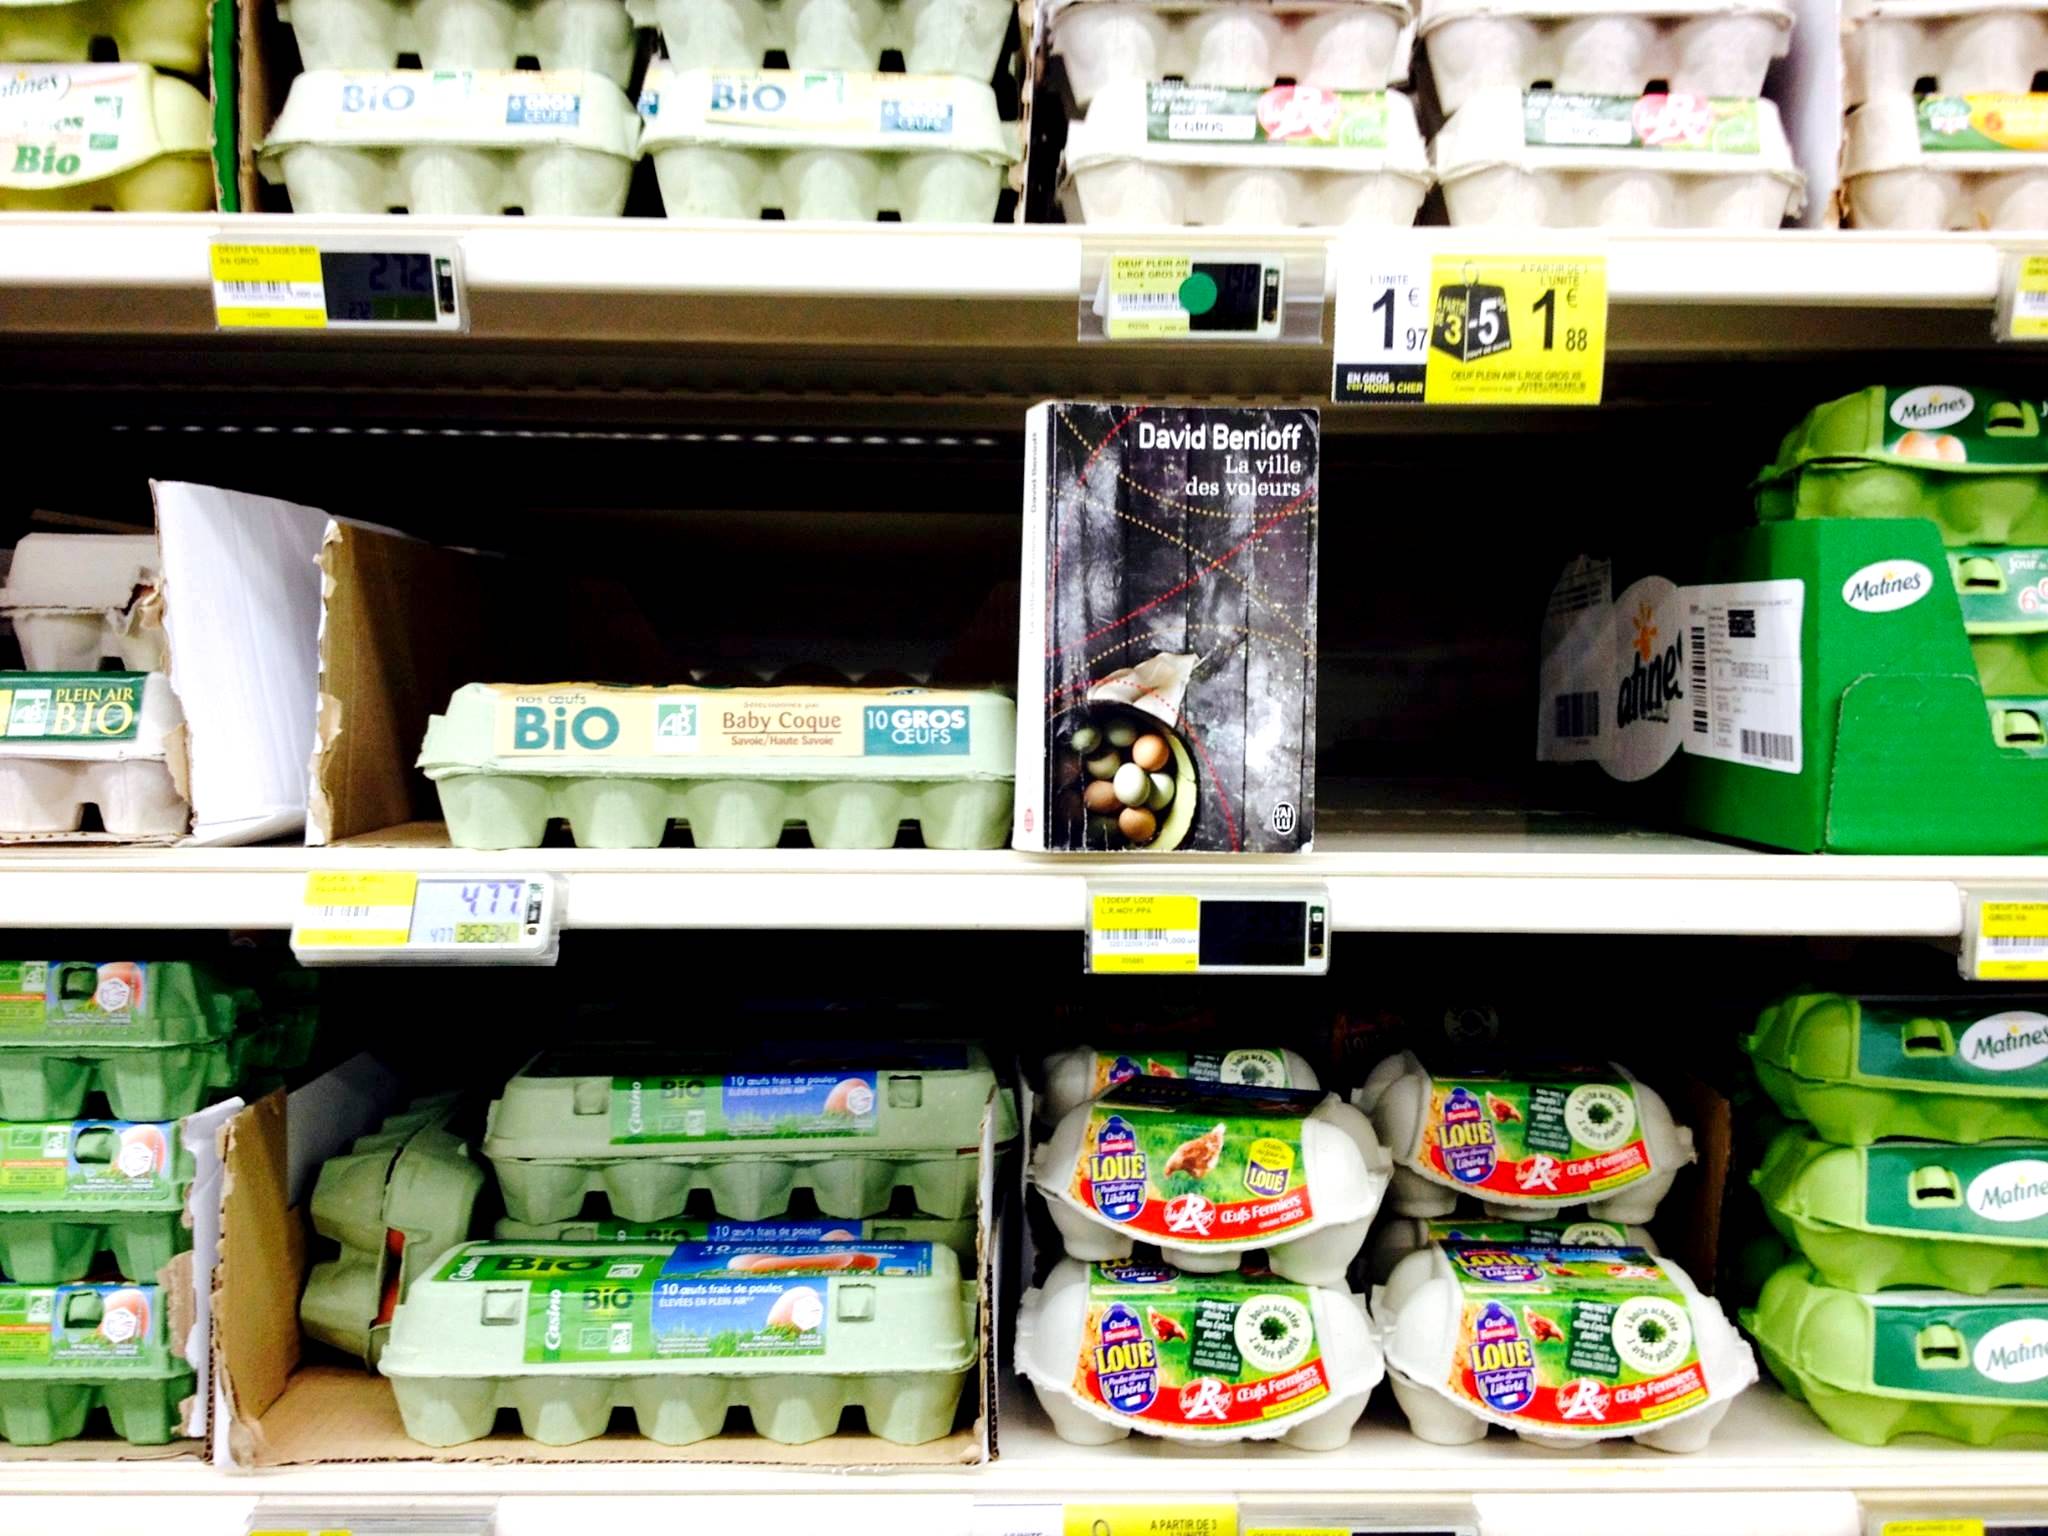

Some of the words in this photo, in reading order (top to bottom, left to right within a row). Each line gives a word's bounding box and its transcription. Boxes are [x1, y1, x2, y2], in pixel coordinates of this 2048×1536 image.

[342, 85, 415, 112] BiO
[711, 83, 786, 112] BiO
[13, 144, 80, 175] Bio
[1146, 260, 1173, 268] PLEIN
[1372, 288, 1396, 351] 1
[1405, 328, 1428, 351] 97
[1444, 315, 1462, 345] 3
[1532, 289, 1556, 350] 1
[1565, 328, 1588, 351] 88
[1362, 371, 1390, 383] GROS
[1363, 382, 1396, 395] MOINS
[1397, 382, 1424, 394] CHER
[1900, 397, 1967, 423] Matines
[1138, 422, 1206, 450] David
[1212, 423, 1303, 450] Benioff
[1225, 455, 1249, 474] La
[1255, 455, 1301, 474] ville
[1185, 476, 1219, 496] des
[1226, 476, 1301, 497] voleurs
[1849, 573, 1921, 602] Matines
[55, 687, 101, 702] PLEIN
[105, 687, 134, 701] AIR
[53, 701, 133, 735] BIO
[514, 706, 620, 750] BiO
[723, 711, 771, 734] Baby
[779, 711, 842, 733] Coque
[867, 710, 888, 730] 10
[891, 709, 966, 730] GROS
[801, 735, 834, 746] Savoie
[891, 729, 952, 744] ŒUFS
[661, 1080, 706, 1100] BiO
[730, 1076, 745, 1086] 10
[746, 1077, 770, 1086] œufs
[771, 1076, 796, 1086] frais
[797, 1076, 808, 1085] de
[808, 1076, 838, 1086] poules
[628, 1080, 643, 1135] Casino
[1251, 1195, 1302, 1218] Fermiers
[1980, 1180, 2048, 1210] Matine
[715, 1226, 730, 1237] 10
[755, 1227, 778, 1236] frais
[778, 1227, 791, 1236] de
[791, 1227, 822, 1237] poules
[495, 1256, 605, 1272] BiO
[582, 1287, 634, 1311] BiO
[661, 1283, 678, 1295] 10
[679, 1284, 707, 1295] œufs
[709, 1284, 732, 1295] frais
[733, 1284, 748, 1294] de
[749, 1284, 783, 1295] poules
[708, 1297, 732, 1306] PLEIN
[544, 1288, 563, 1350] Casino
[1113, 1380, 1148, 1398] Liberté
[1236, 1382, 1268, 1402] Œufs
[1268, 1364, 1318, 1394] Fermiers
[1490, 1379, 1525, 1396] Liberté
[1646, 1367, 1697, 1396] Fermiers
[1150, 1520, 1157, 1531] A
[1159, 1520, 1191, 1531] PARTIR
[1192, 1520, 1209, 1530] DE
